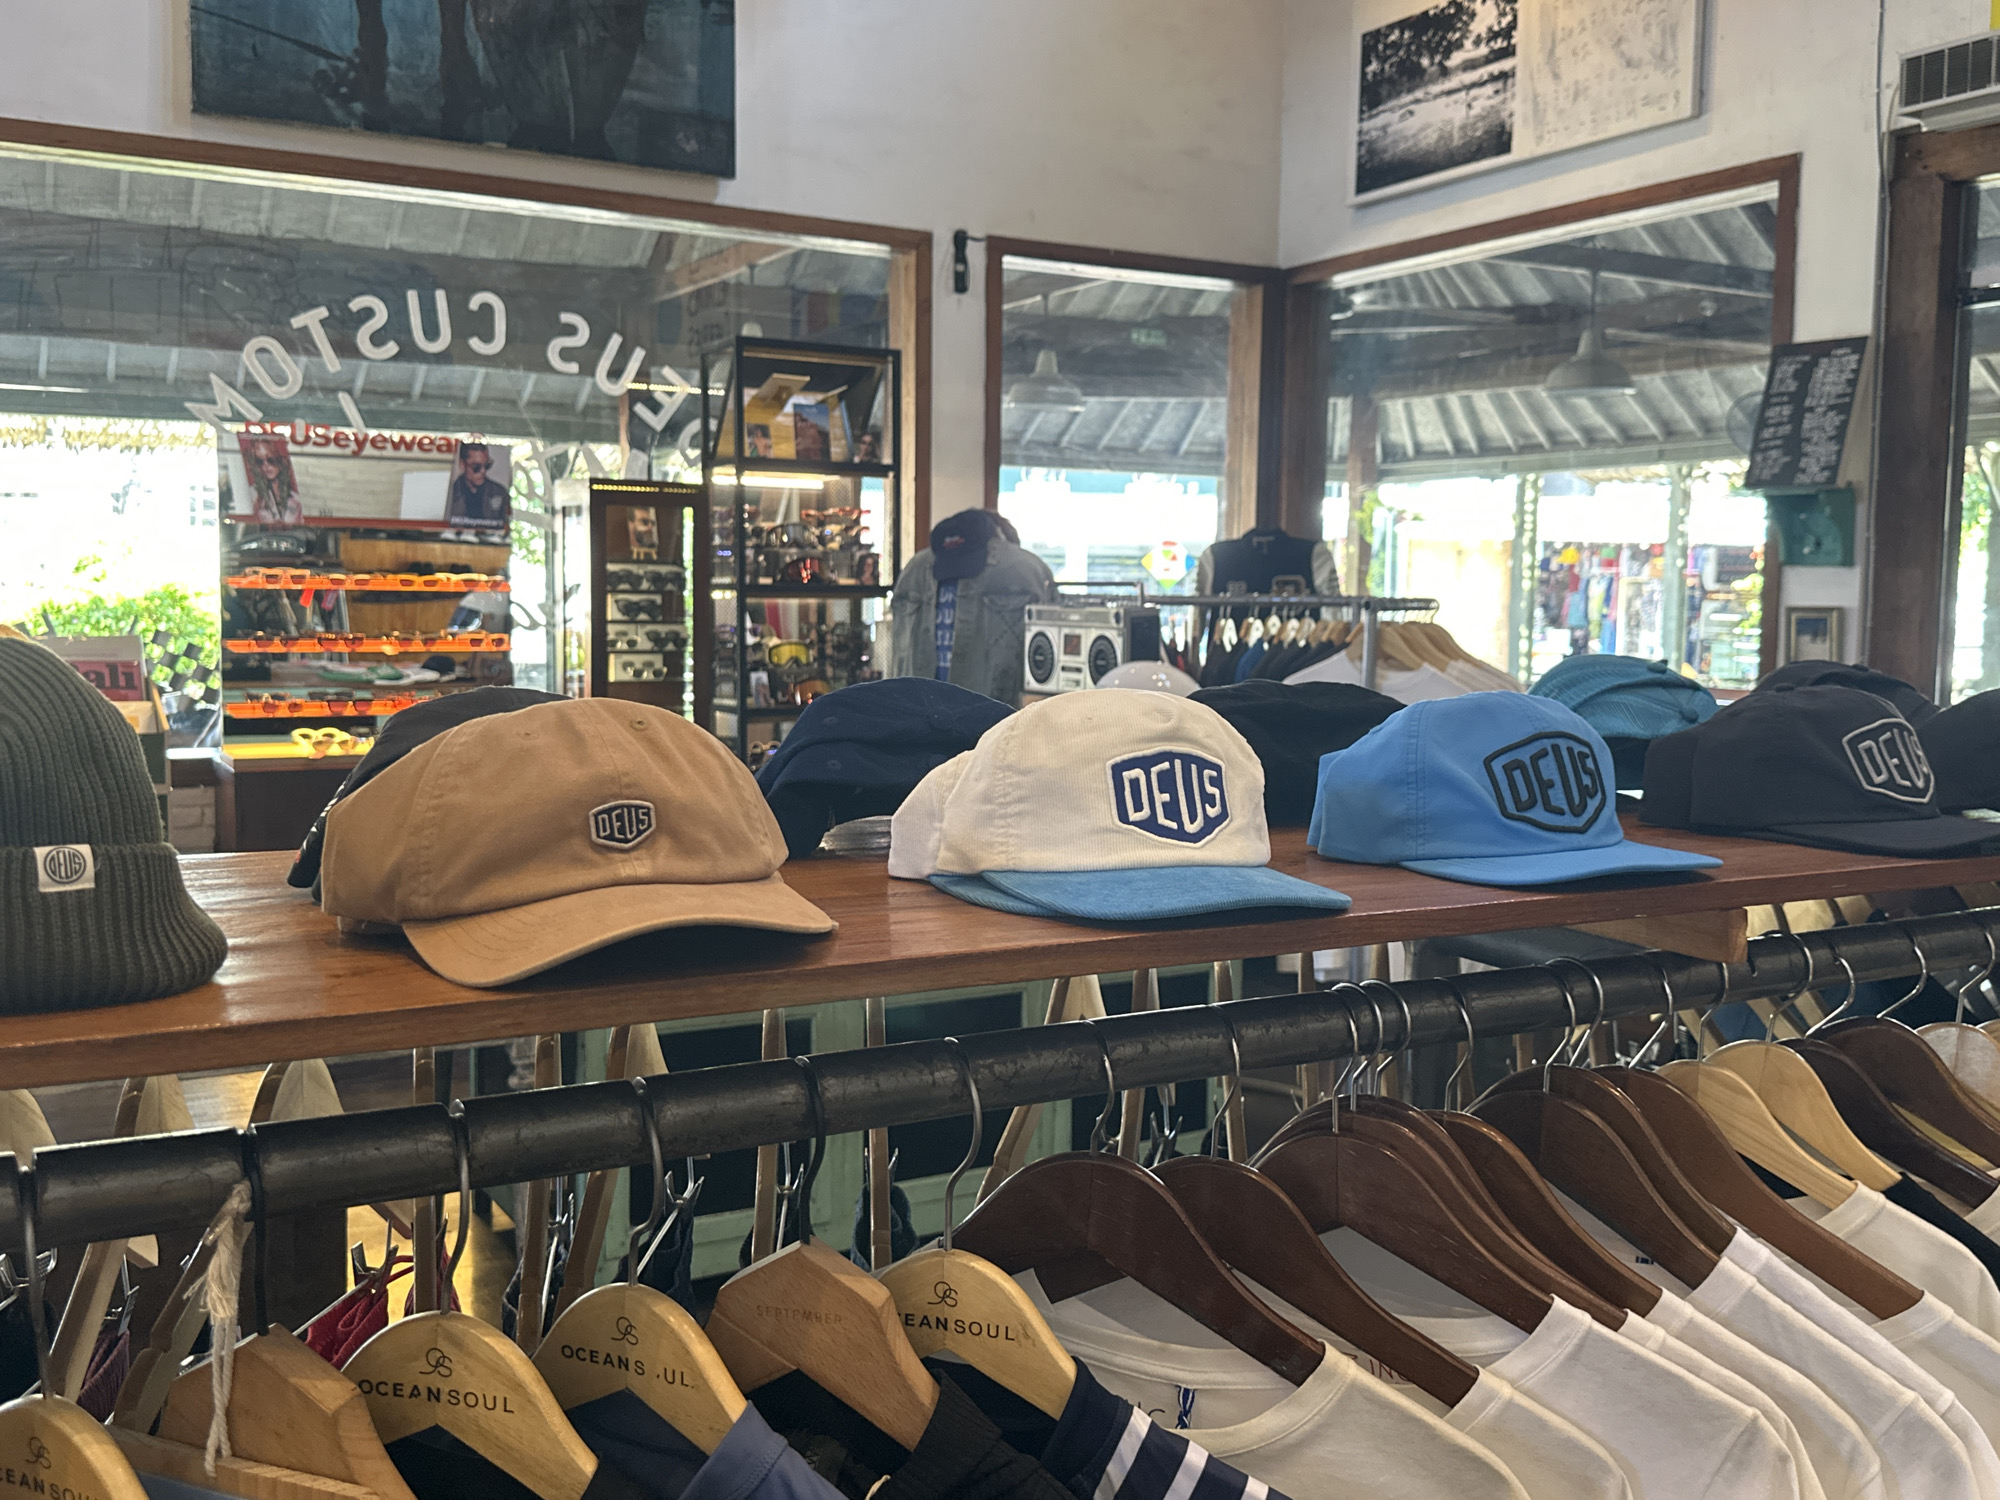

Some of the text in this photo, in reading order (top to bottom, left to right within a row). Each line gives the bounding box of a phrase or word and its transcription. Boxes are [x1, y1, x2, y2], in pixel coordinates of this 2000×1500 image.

[70, 662, 139, 690] ali
[1857, 729, 1929, 789] DEUS
[1122, 759, 1222, 834] DEUS
[1502, 744, 1599, 817] DEUS
[598, 808, 649, 840] DEUS
[49, 850, 83, 880] DEUS
[898, 1312, 1016, 1341] EANSOUL
[561, 1344, 695, 1389] OCEANSUL
[358, 1379, 515, 1414] OCEANSOUL
